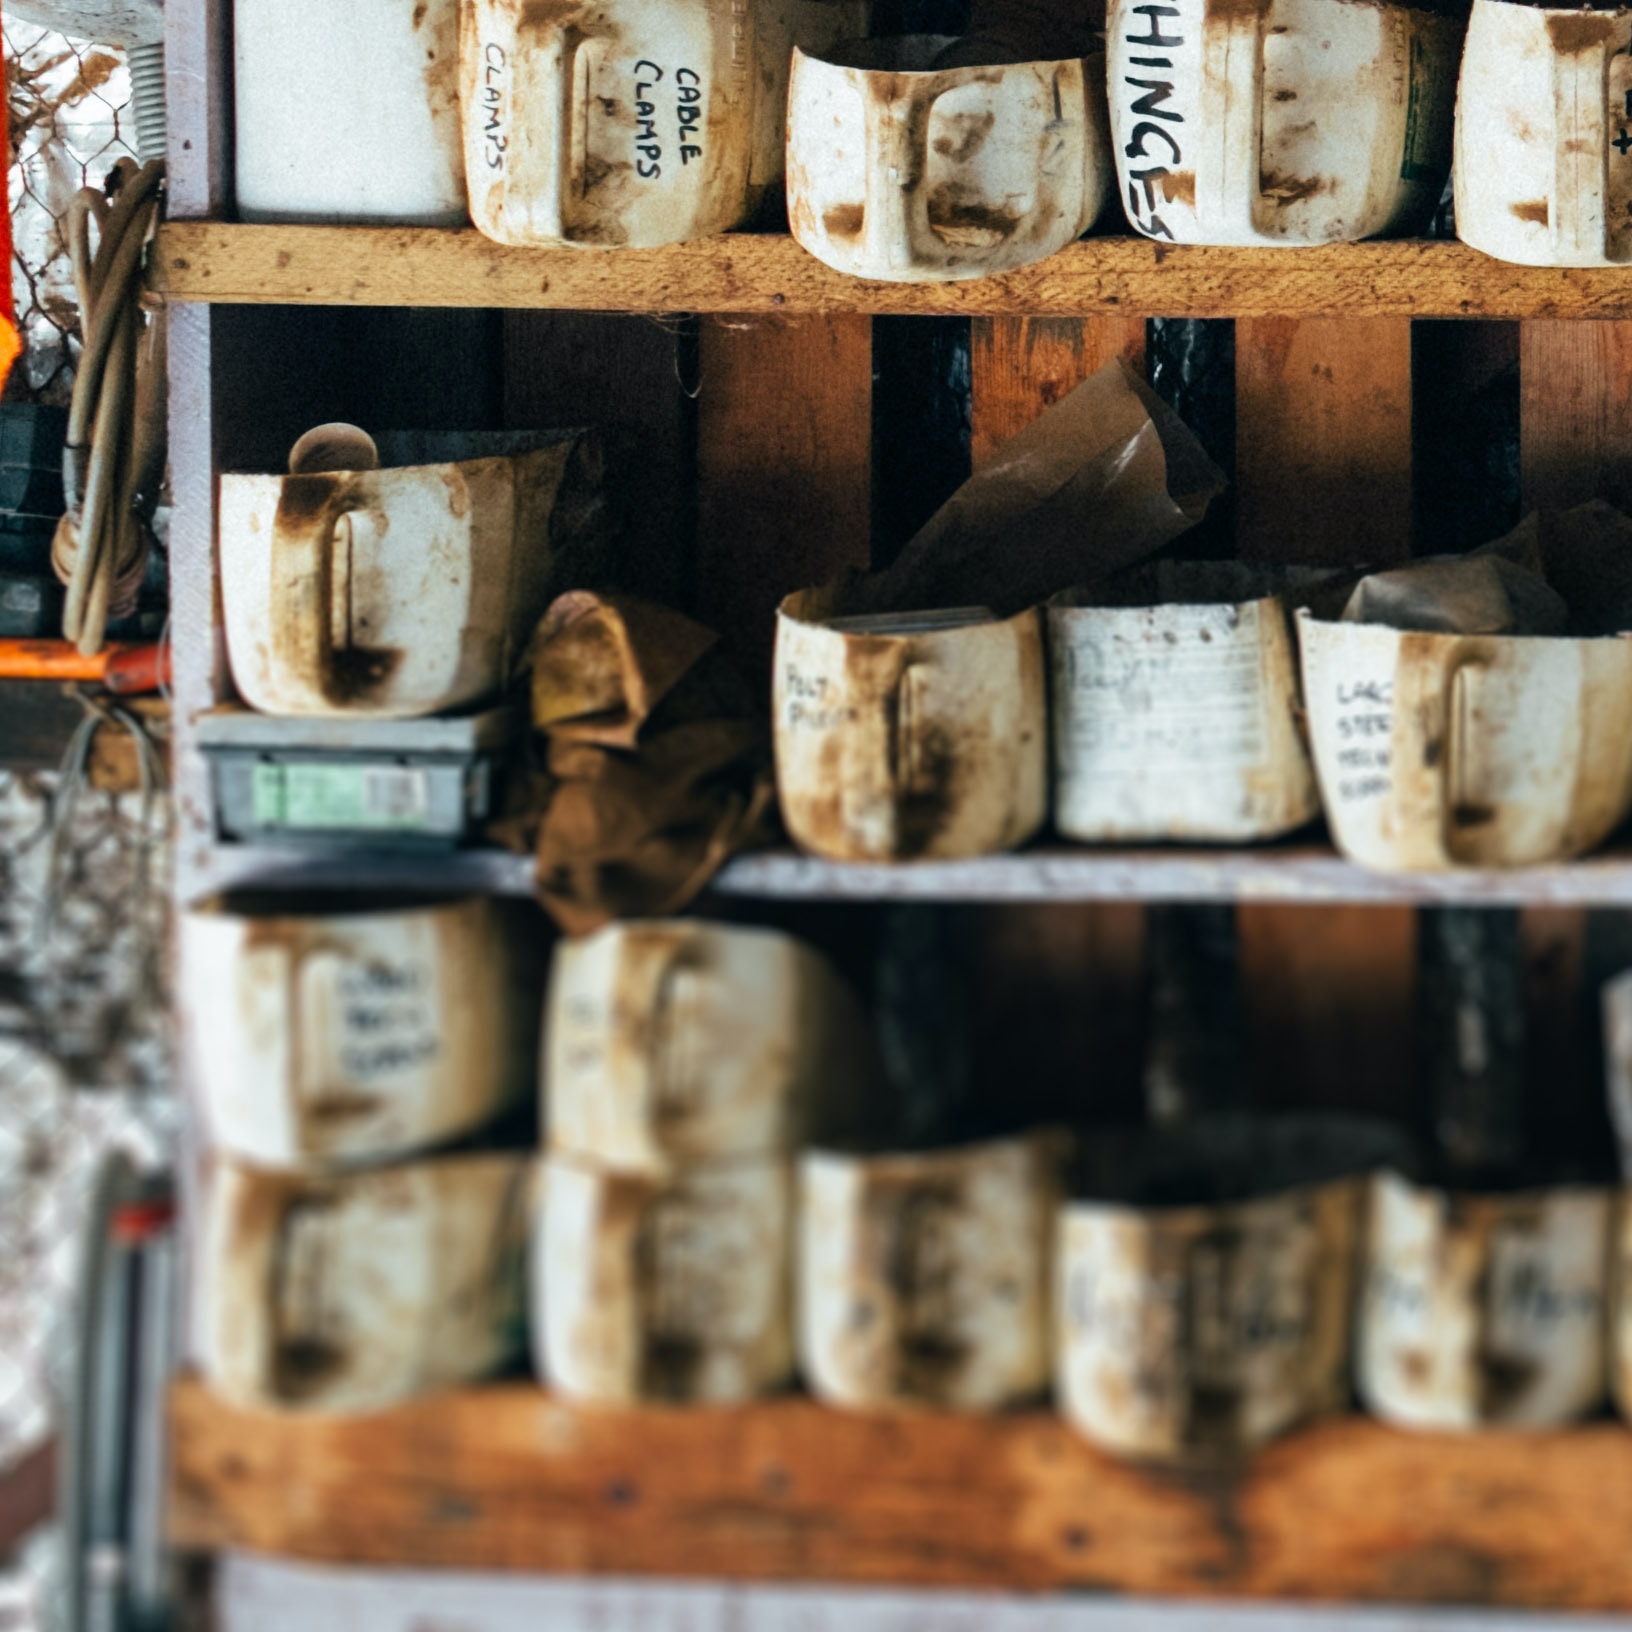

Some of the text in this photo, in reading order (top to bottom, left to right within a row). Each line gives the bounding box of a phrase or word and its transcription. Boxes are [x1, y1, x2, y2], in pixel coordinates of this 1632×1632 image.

[475, 40, 508, 172] CLAMPS
[634, 58, 664, 180] CLAMPS
[675, 66, 703, 167] CABLE
